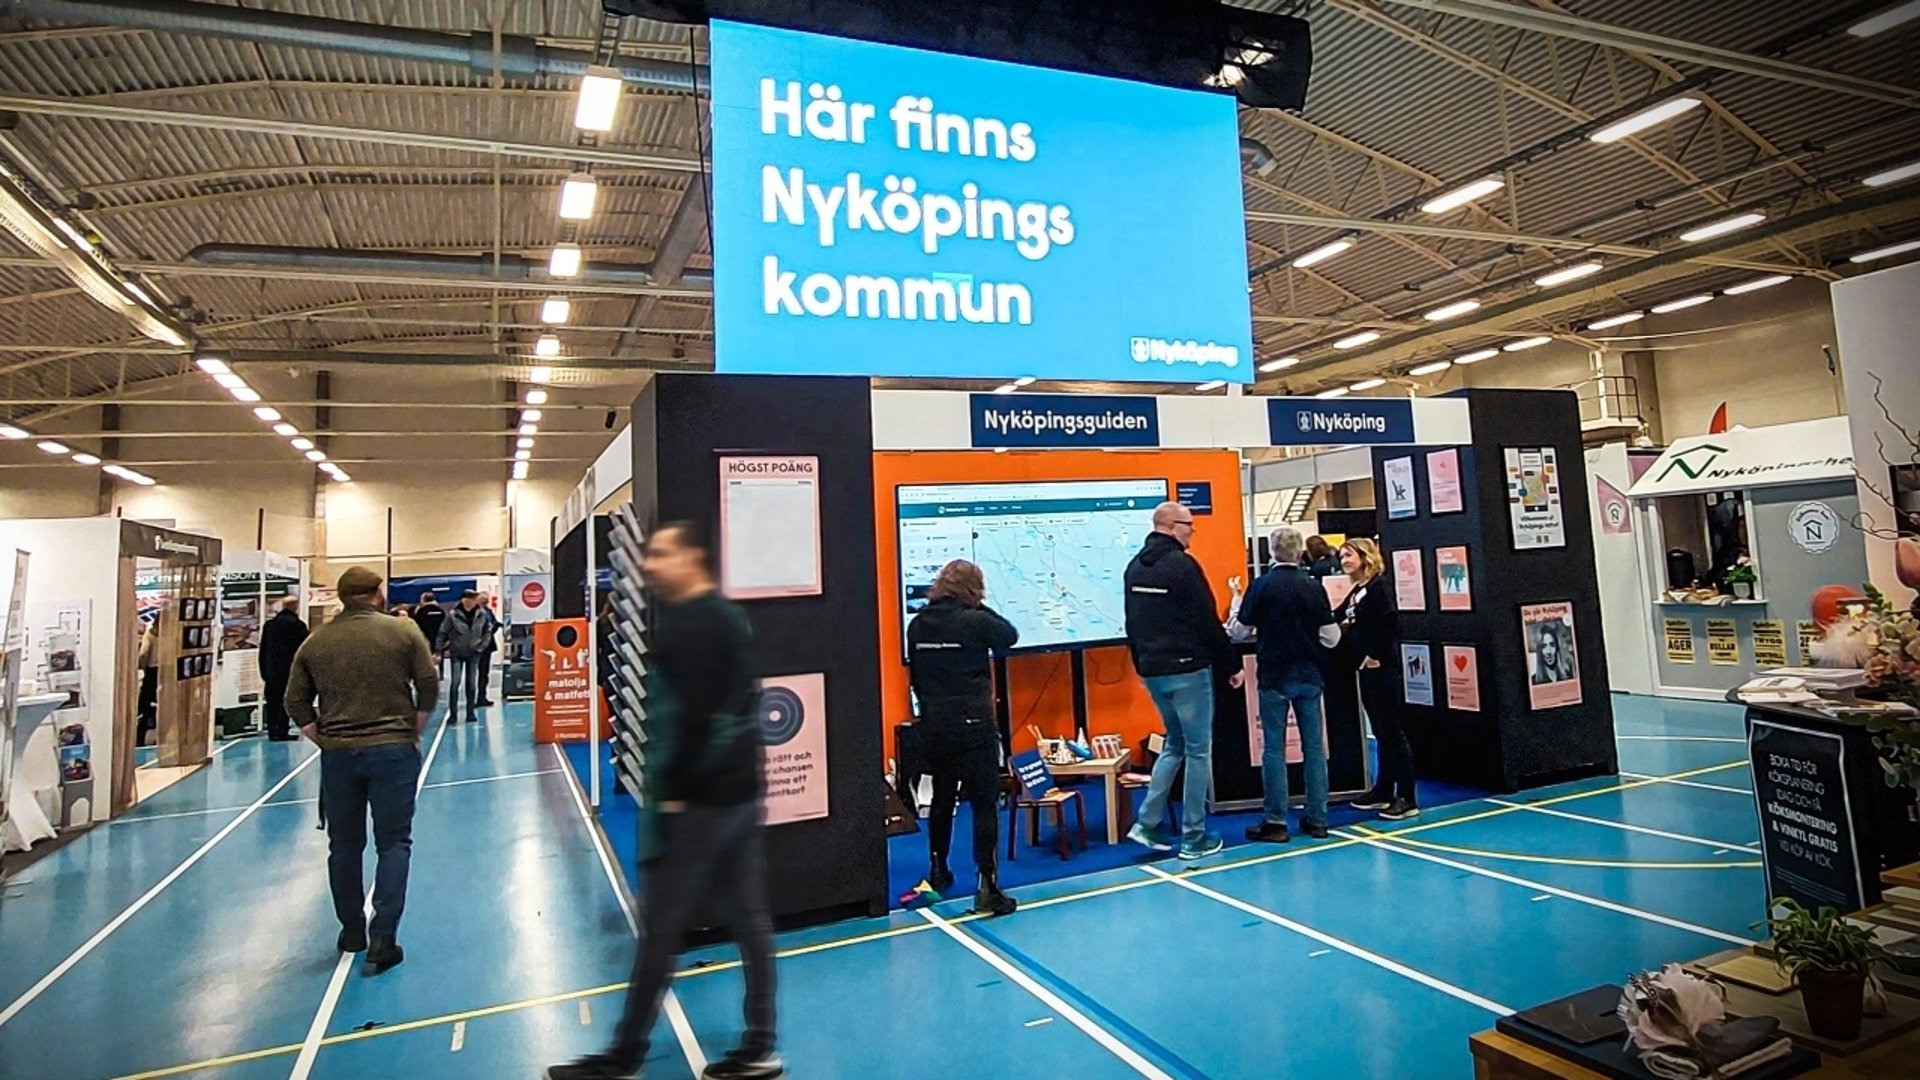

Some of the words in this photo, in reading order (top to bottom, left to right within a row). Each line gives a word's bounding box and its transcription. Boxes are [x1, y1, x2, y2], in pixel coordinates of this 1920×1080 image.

[760, 77, 876, 145] Här
[889, 96, 1036, 162] finns
[761, 164, 1075, 260] Nyköpings
[763, 255, 1034, 325] kommun
[1150, 338, 1239, 367] Nyköping
[984, 410, 1147, 435] Nyköpingsguiden
[1313, 411, 1386, 433] Nyköping
[728, 460, 769, 473] HÖGST
[771, 460, 813, 473] POÄNG
[543, 690, 552, 701] &
[548, 677, 587, 698] matolja
[773, 753, 792, 764] rätt
[793, 750, 812, 761] och
[1769, 754, 1790, 768] BOKA
[1802, 760, 1817, 775] FÖR
[773, 763, 814, 775] chansen
[793, 774, 807, 784] ett
[1767, 801, 1838, 834] KÖKSMONTERING
[1772, 820, 1779, 832] &
[1780, 822, 1808, 842] VINKYL
[1808, 833, 1838, 853] GRATIS
